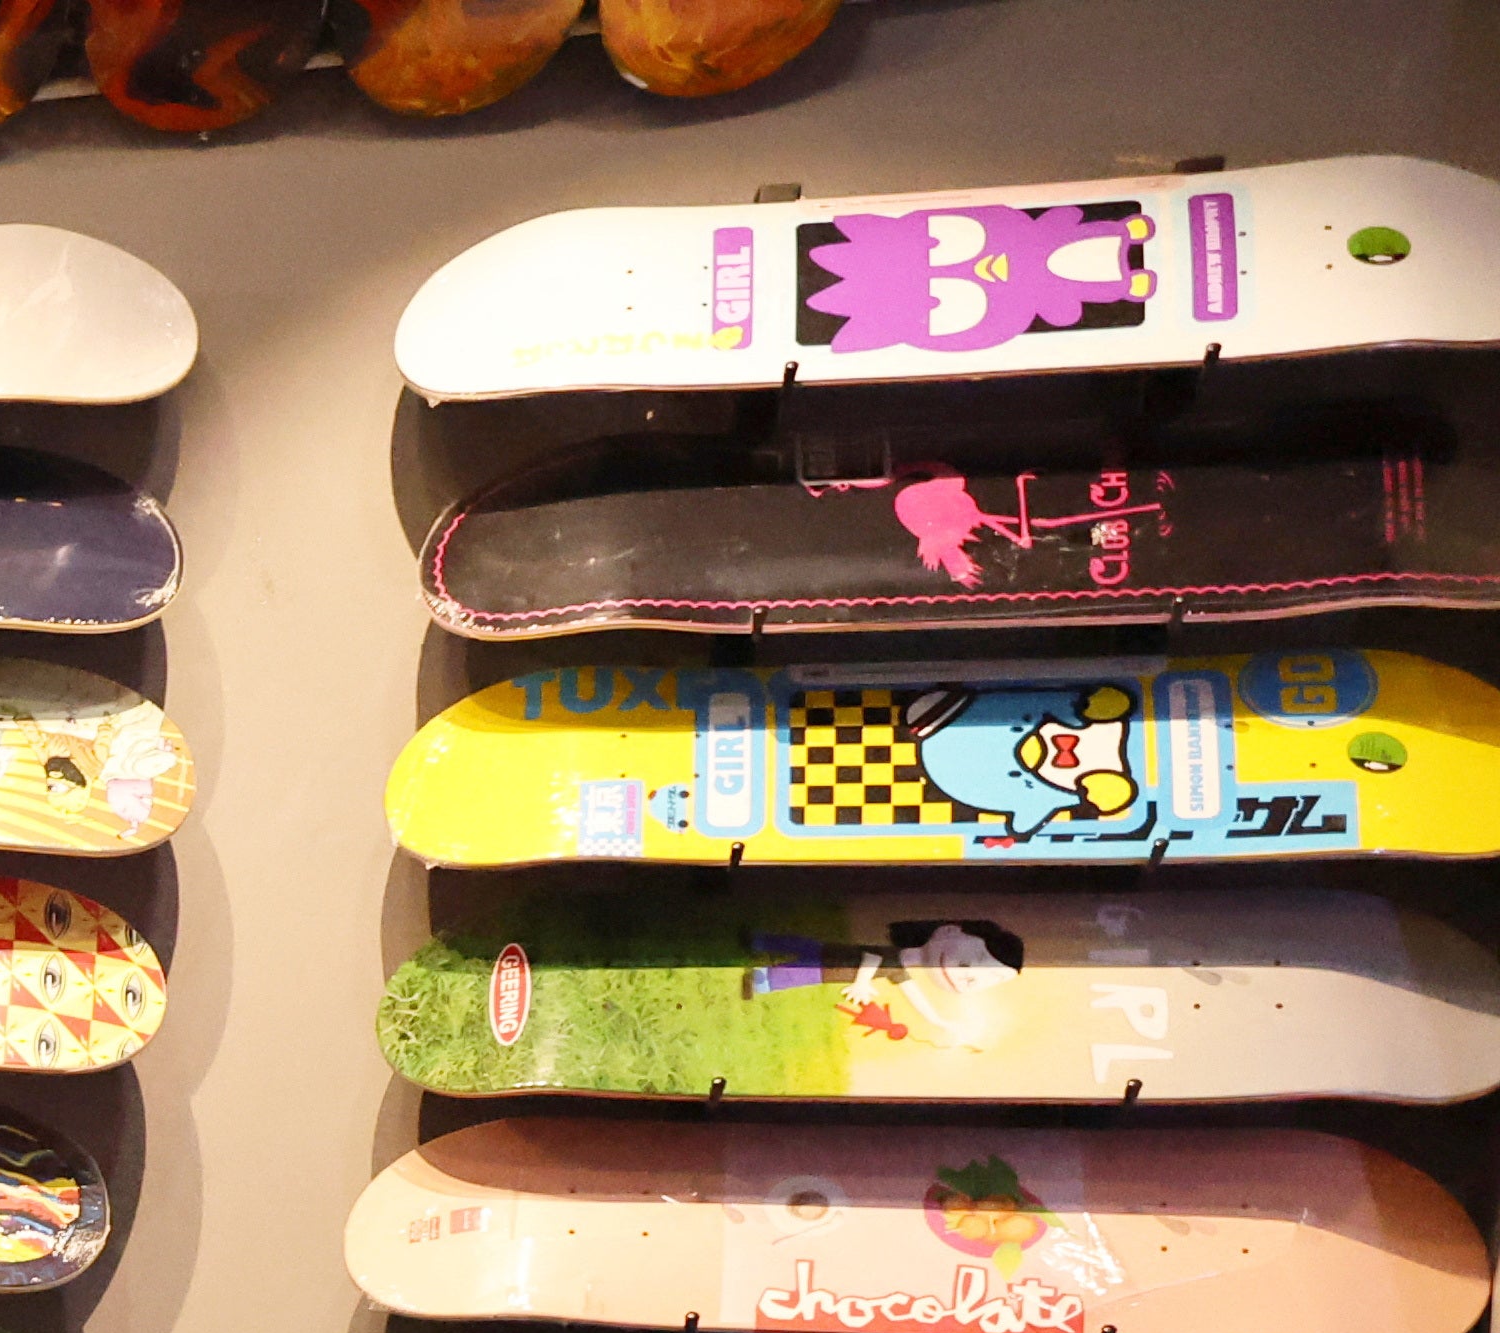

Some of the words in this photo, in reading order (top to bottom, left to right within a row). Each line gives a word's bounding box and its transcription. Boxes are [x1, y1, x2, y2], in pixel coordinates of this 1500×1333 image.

[715, 244, 751, 323] GIRL
[1088, 518, 1130, 586] CLUB
[714, 737, 746, 797] GIRL
[499, 955, 522, 1034] GEERING
